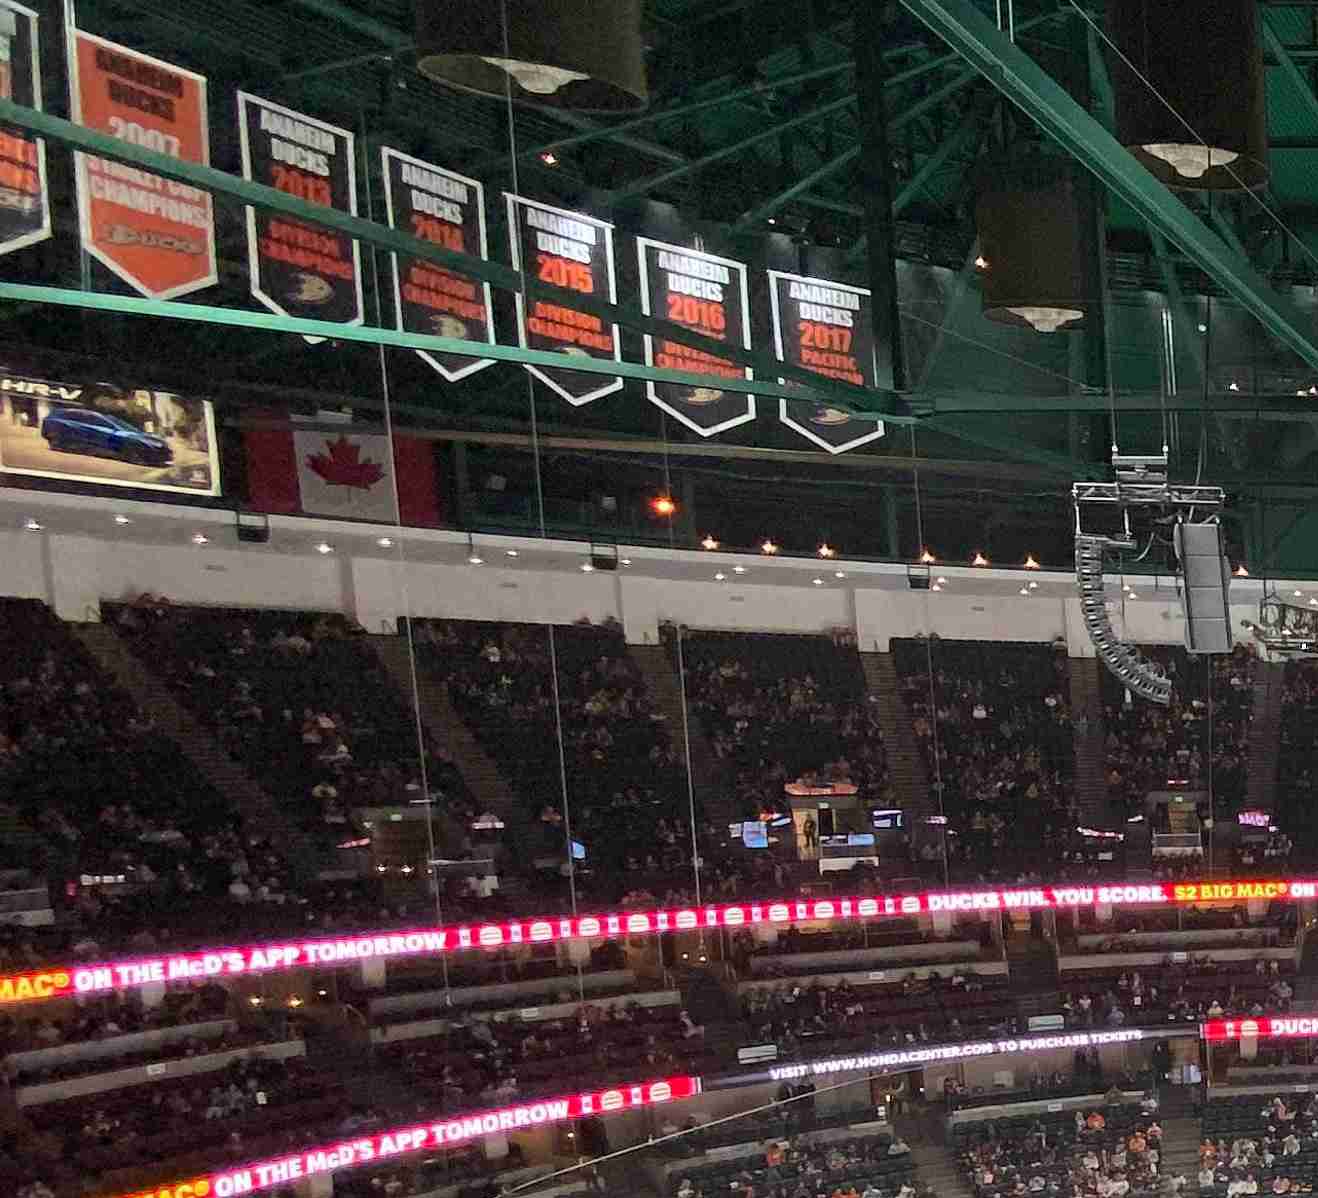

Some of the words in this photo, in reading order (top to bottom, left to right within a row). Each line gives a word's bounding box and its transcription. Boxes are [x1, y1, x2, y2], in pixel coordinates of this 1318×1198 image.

[536, 231, 592, 265] DUCKS
[536, 254, 593, 293] 2015
[658, 250, 730, 285] ANAHEIM
[667, 272, 724, 303] DUCKS
[788, 281, 860, 311] ANAHEIM
[666, 293, 726, 331] 2016
[799, 301, 854, 328] DUCKS
[797, 320, 852, 353] 2017
[927, 891, 1000, 909] DUCKS
[1051, 887, 1095, 906] YOU
[1201, 883, 1233, 899] BIG
[1290, 881, 1315, 896] ON
[74, 970, 113, 992] ON
[116, 962, 165, 985] THE
[249, 946, 300, 970] APP
[303, 932, 448, 961] TOMORROW
[769, 1064, 808, 1077] VISIT
[999, 1041, 1018, 1052] TO
[1020, 1034, 1089, 1050] PURCHASE
[1090, 1030, 1144, 1045] TICKETS
[214, 1169, 253, 1198] ON
[256, 1158, 302, 1187] THE
[306, 1140, 375, 1175] McD'S
[378, 1129, 428, 1161] APP
[432, 1100, 569, 1139] TOMORROW
